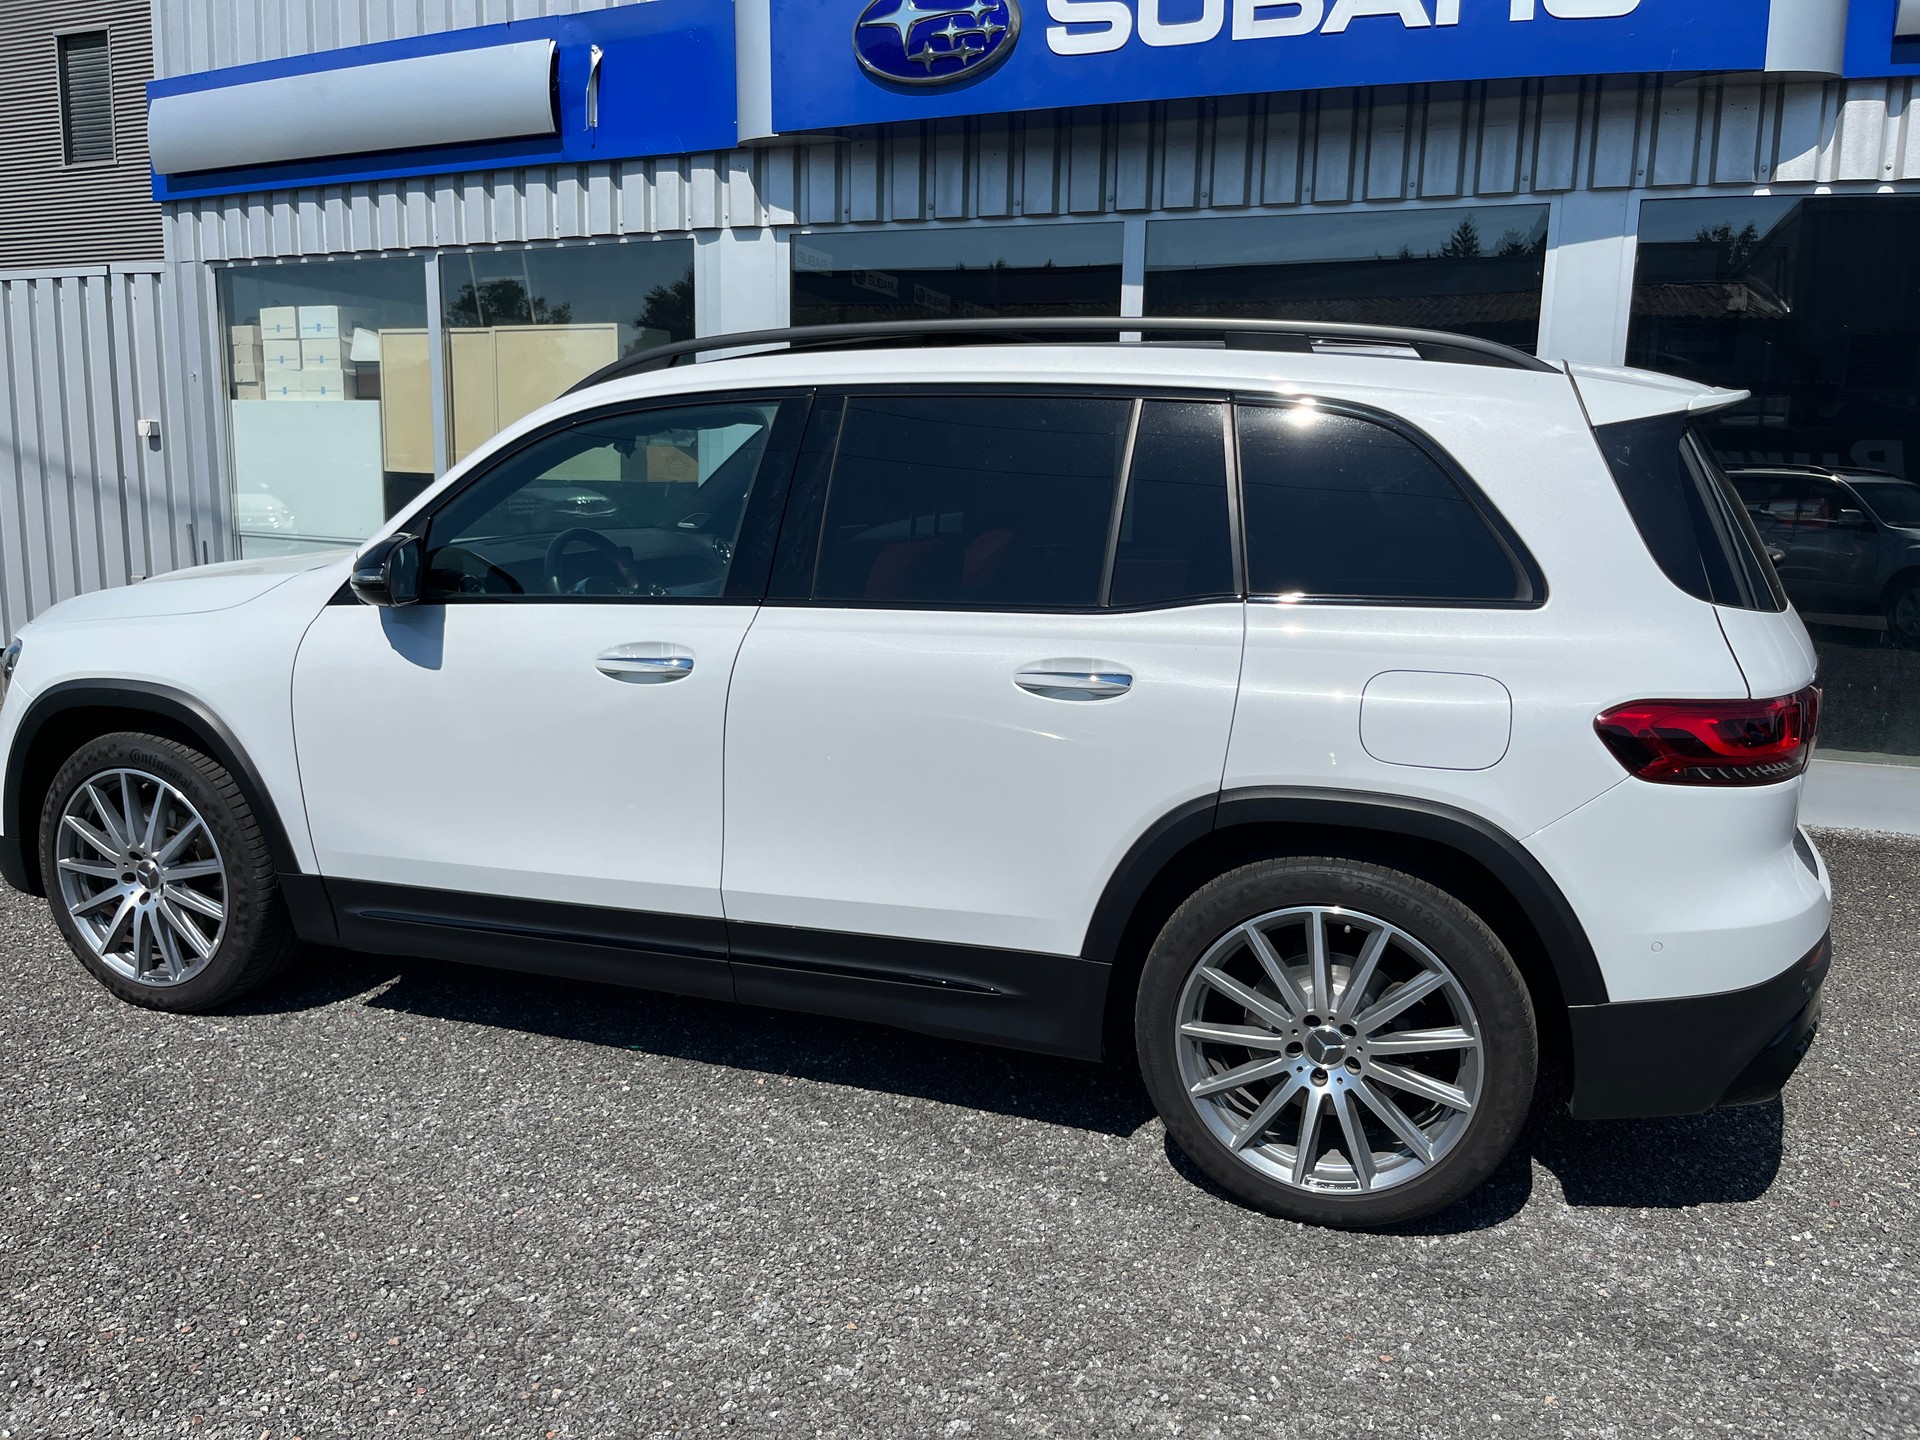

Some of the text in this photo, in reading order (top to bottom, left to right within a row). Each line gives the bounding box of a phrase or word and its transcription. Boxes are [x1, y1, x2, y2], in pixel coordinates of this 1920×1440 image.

[1045, 0, 1643, 55] SUBA
[867, 273, 898, 294] SUBARU
[129, 748, 193, 790] Continental
[1355, 881, 1409, 910] 235/45
[1411, 903, 1424, 918] R
[1423, 911, 1443, 930] 20
